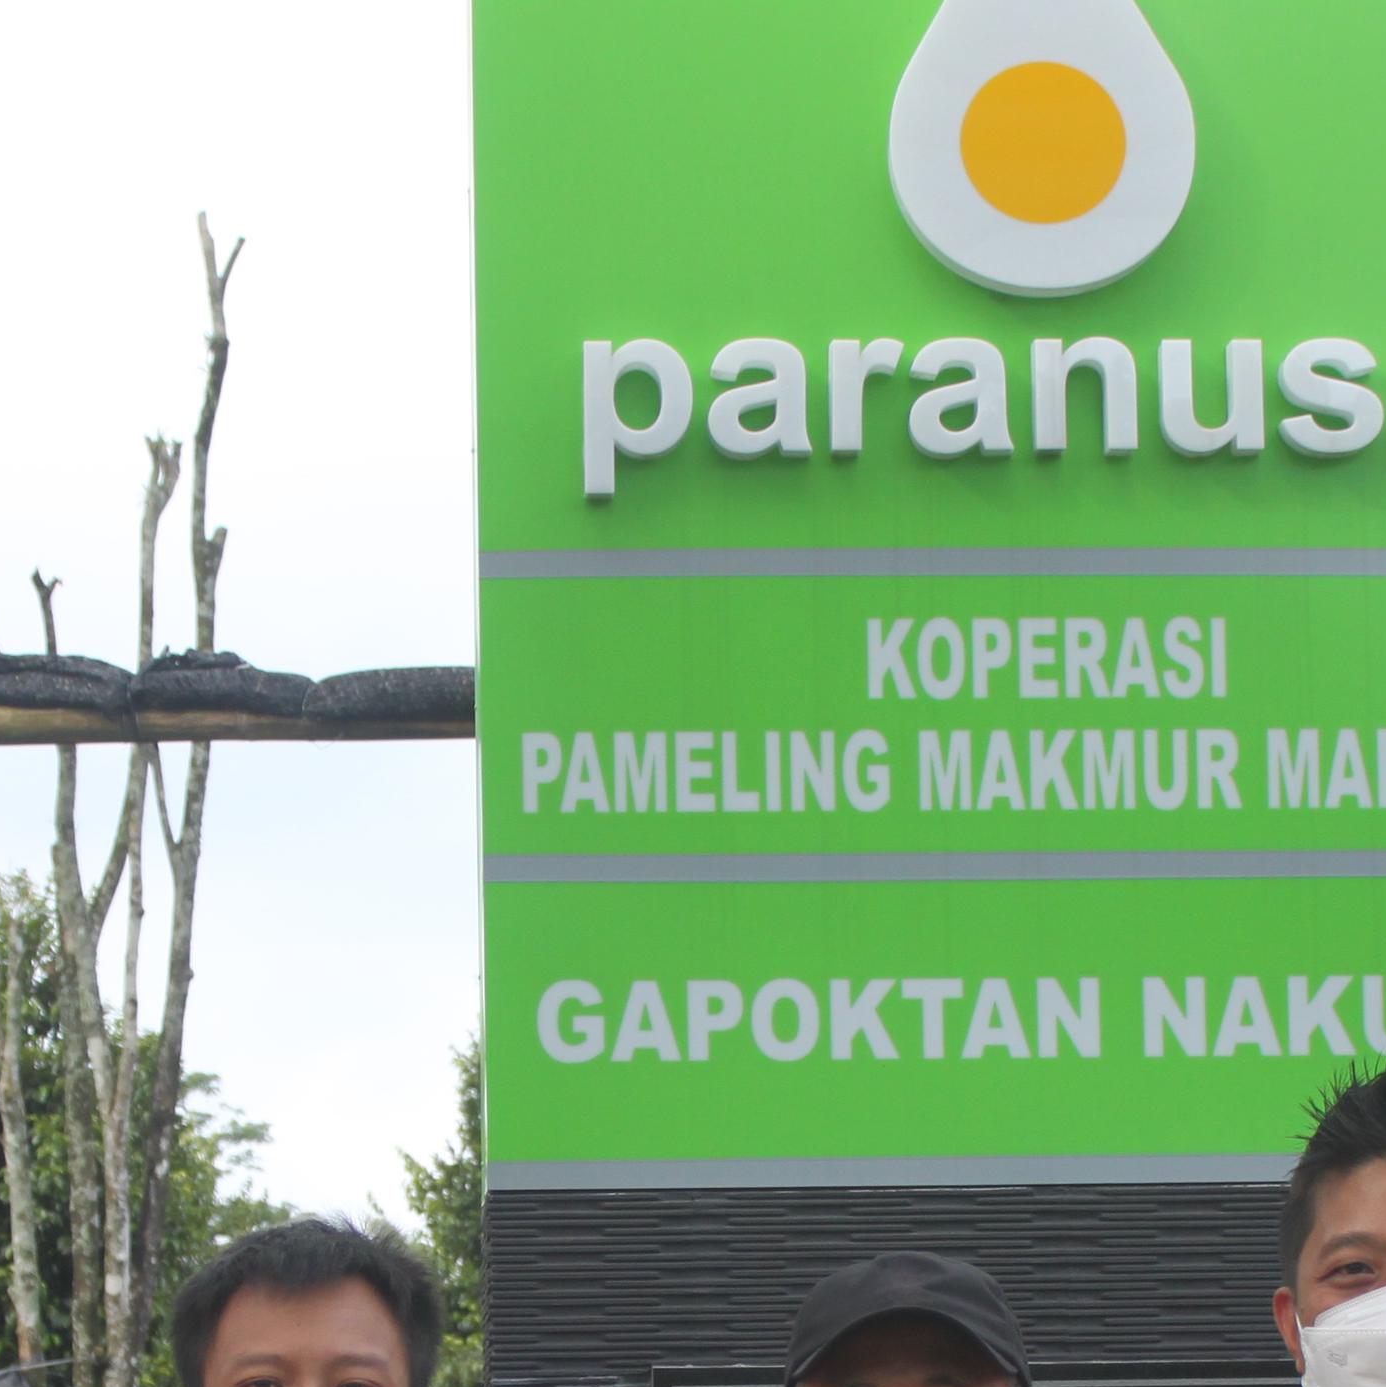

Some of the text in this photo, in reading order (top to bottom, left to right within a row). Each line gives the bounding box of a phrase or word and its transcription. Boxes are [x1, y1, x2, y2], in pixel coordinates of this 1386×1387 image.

[867, 615, 1227, 700] KOPERASI
[521, 728, 891, 813] PAMELING
[918, 728, 1242, 811] MAKMUR
[537, 976, 1102, 1064] GAPOKTAN
